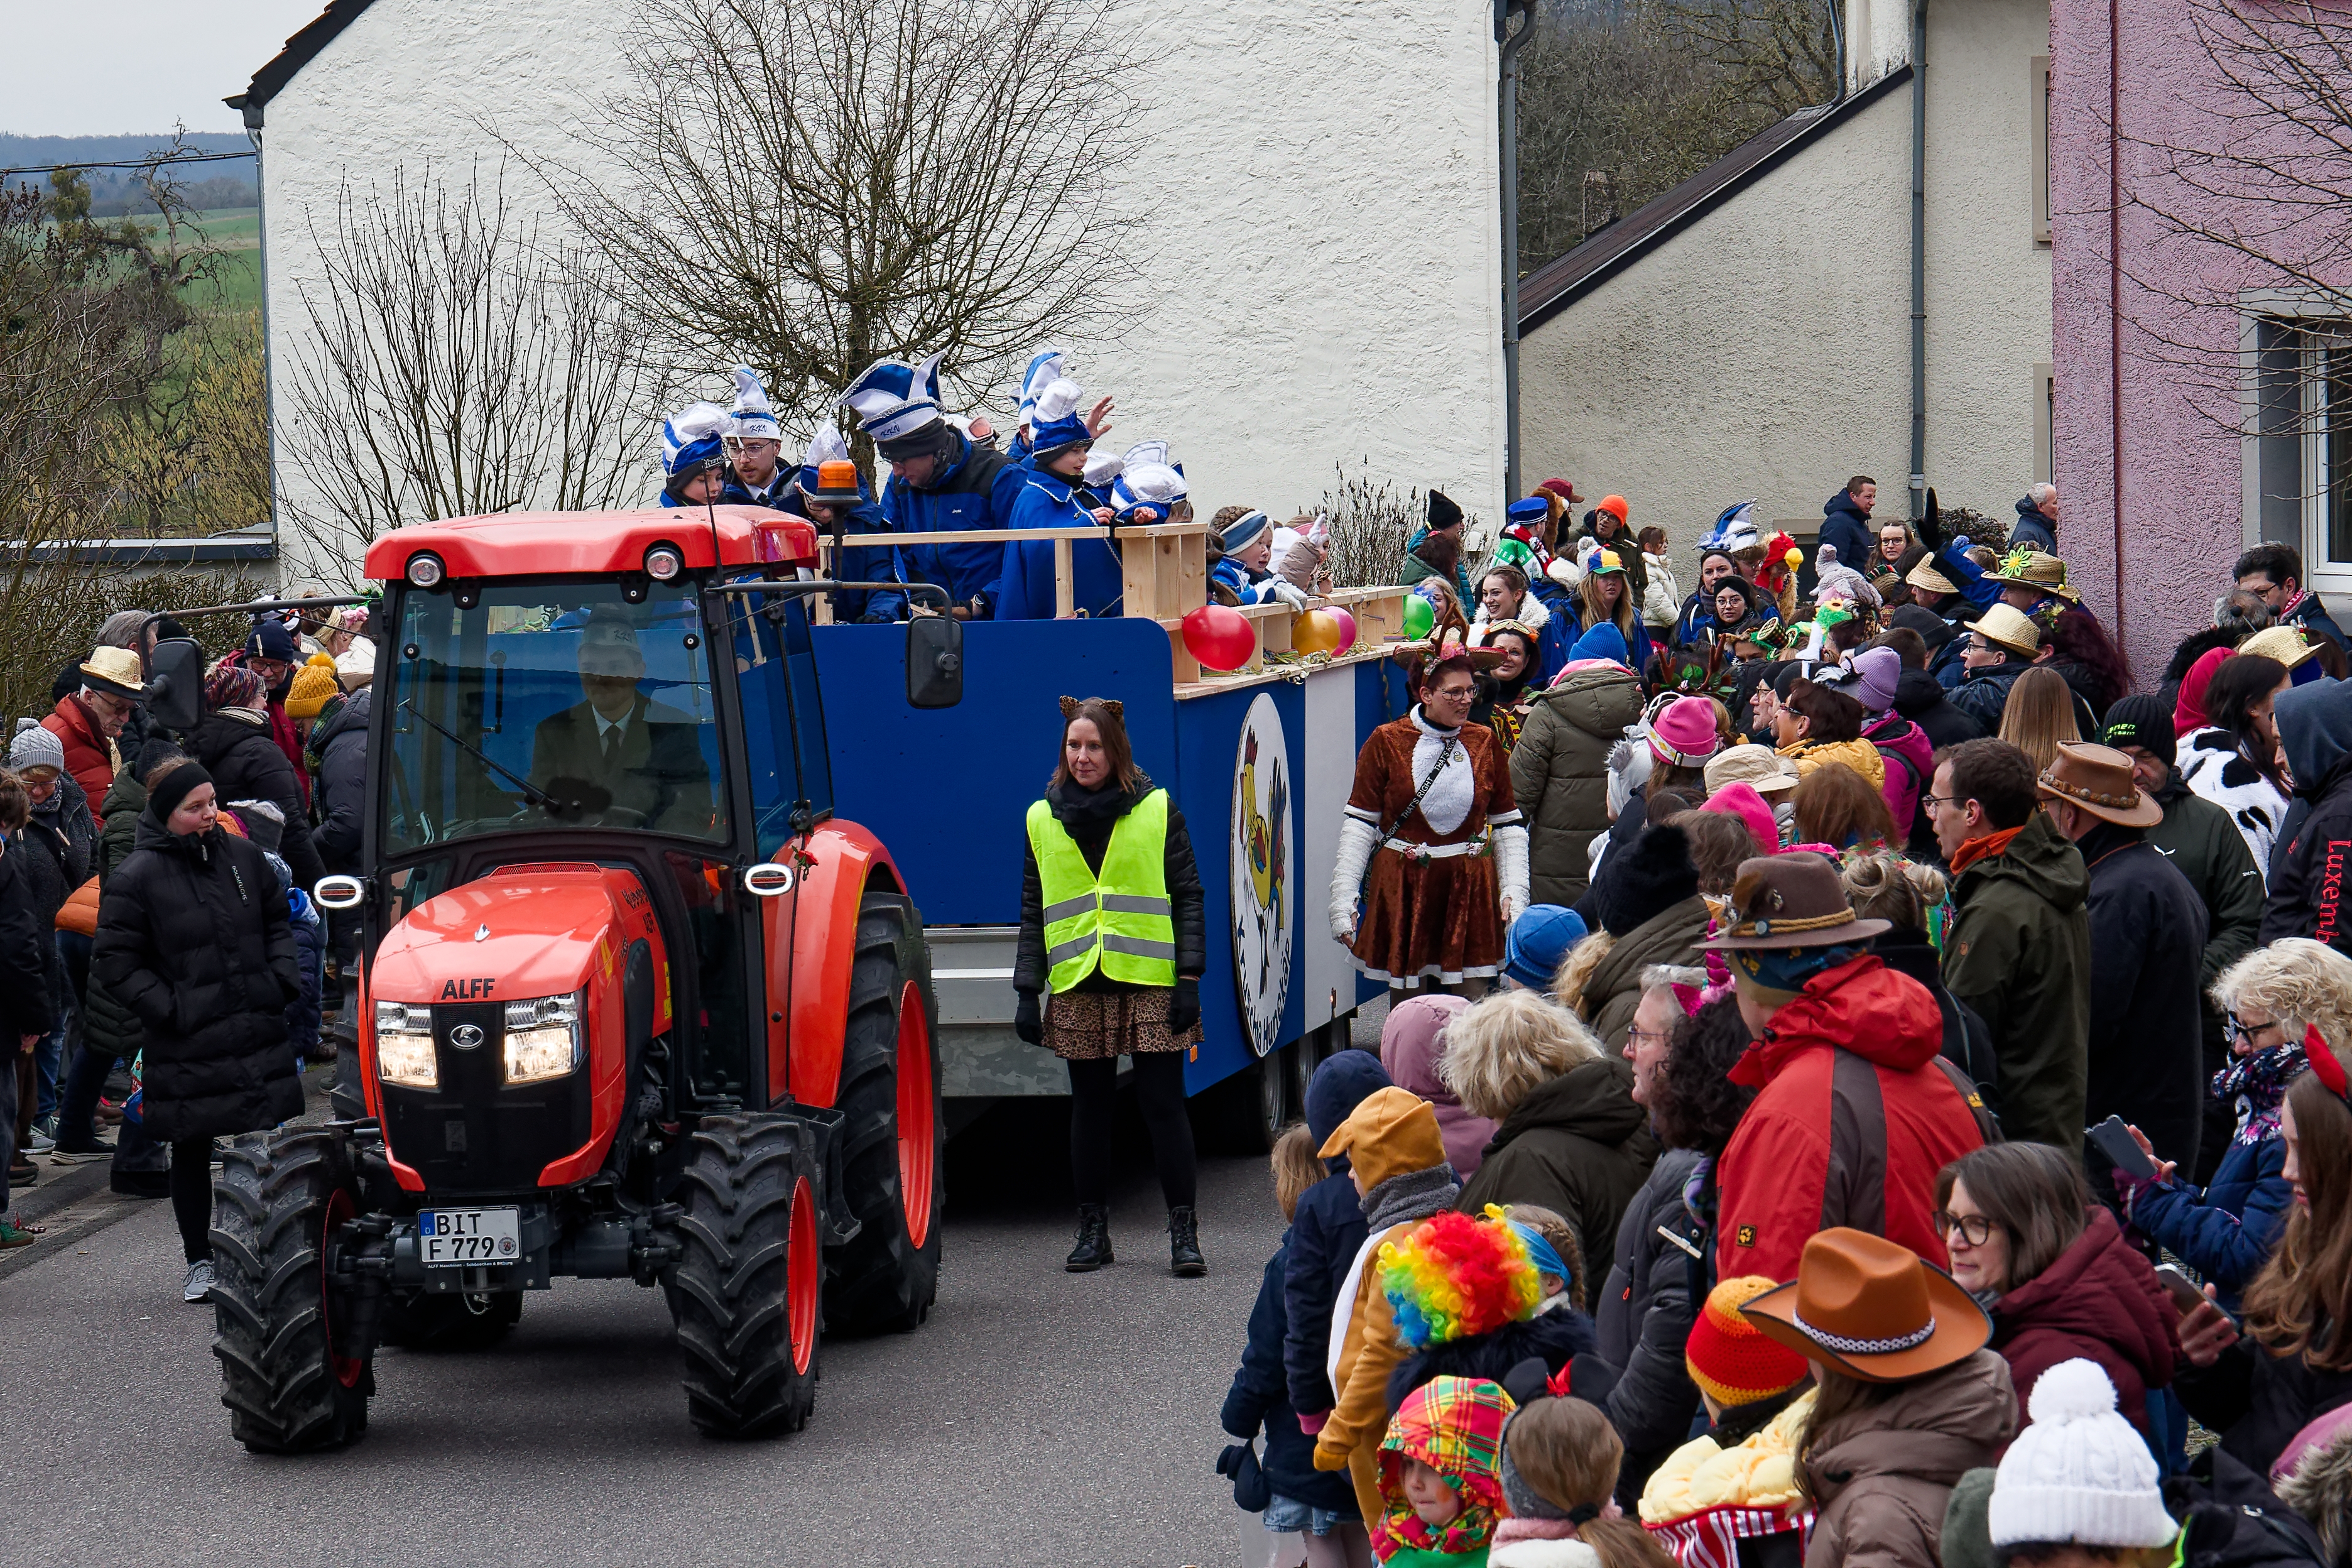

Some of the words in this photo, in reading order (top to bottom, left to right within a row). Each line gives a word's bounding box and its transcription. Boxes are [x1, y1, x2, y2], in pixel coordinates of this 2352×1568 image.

[1417, 776, 1433, 798] RIGHT
[1434, 751, 1449, 771] THAT'S
[440, 978, 495, 1000] ALFF
[436, 1212, 481, 1236] BIT
[428, 1238, 443, 1260] F
[451, 1236, 494, 1259] 779
